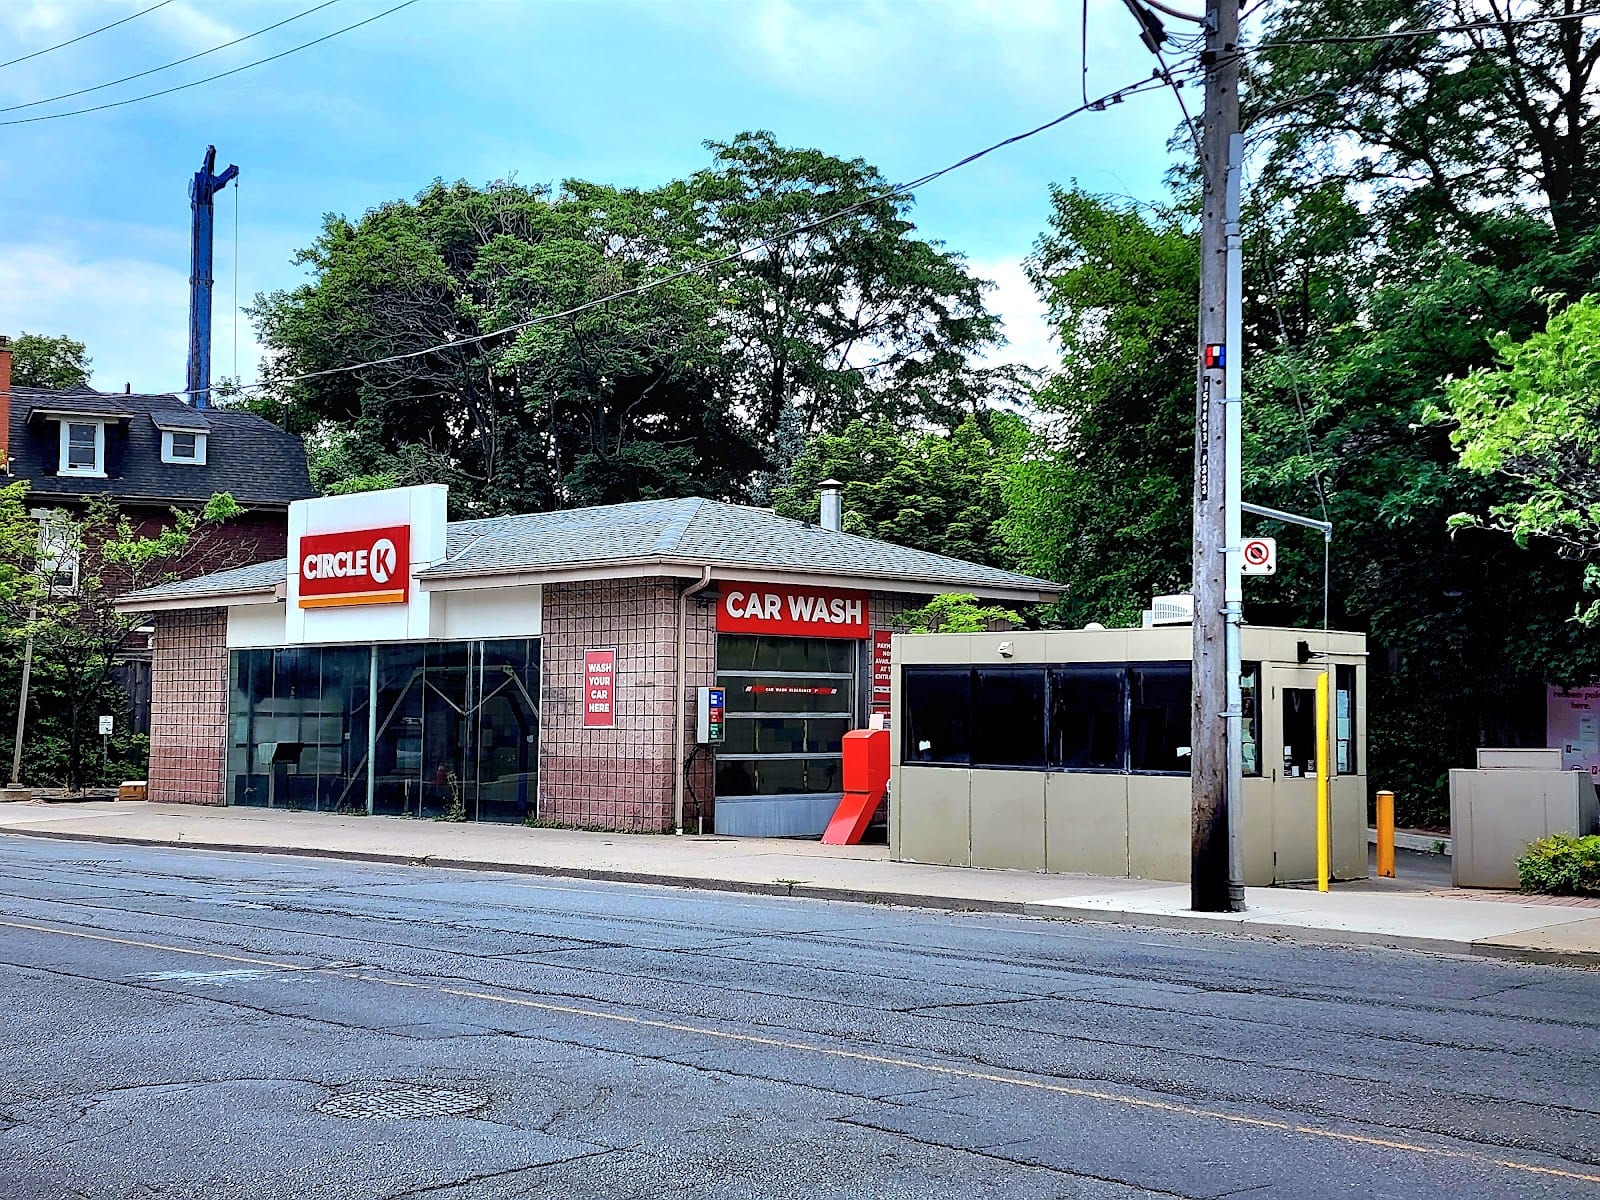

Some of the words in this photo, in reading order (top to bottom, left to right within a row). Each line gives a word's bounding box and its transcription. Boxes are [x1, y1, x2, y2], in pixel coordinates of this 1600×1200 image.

[303, 549, 368, 580] CIRCLE
[374, 546, 396, 584] K
[726, 591, 782, 621] CAR
[787, 595, 862, 625] WASH
[588, 663, 612, 673] WASH
[589, 676, 611, 686] YOUR
[591, 689, 608, 699] CAR
[588, 703, 610, 713] HERE
